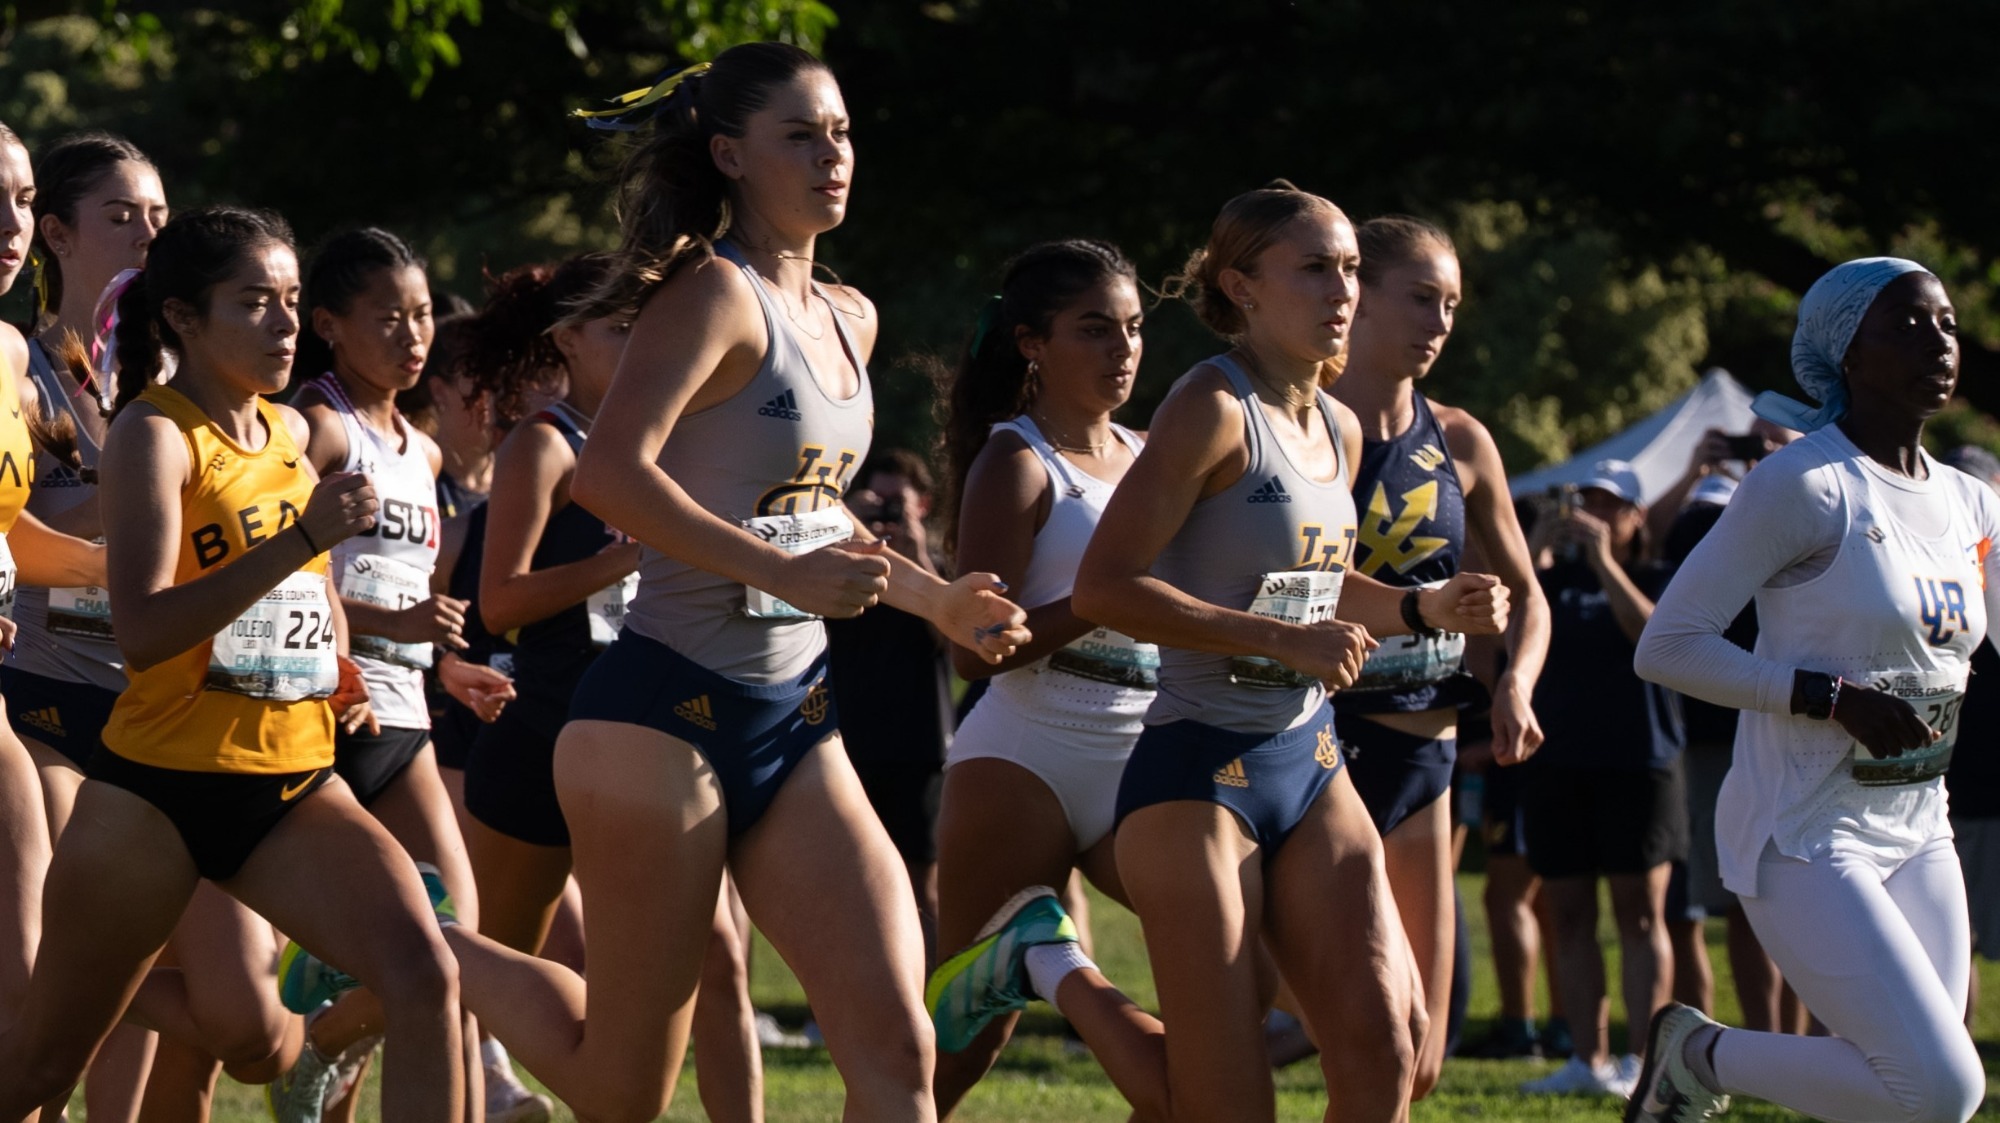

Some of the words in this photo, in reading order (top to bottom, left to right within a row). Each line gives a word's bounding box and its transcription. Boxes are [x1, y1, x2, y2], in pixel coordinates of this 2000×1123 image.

[758, 406, 802, 421] adidas
[1246, 493, 1292, 504] adidas
[780, 531, 809, 544] CROSS
[1281, 587, 1310, 599] CROSS
[1912, 575, 1969, 647] UCR
[231, 619, 273, 638] TOLEDO
[284, 611, 334, 650] 224
[1895, 676, 1917, 687] THE
[1892, 687, 1924, 697] CROSS
[20, 712, 67, 737] adidas
[673, 704, 717, 731] adidas
[1212, 773, 1249, 788] adidas
